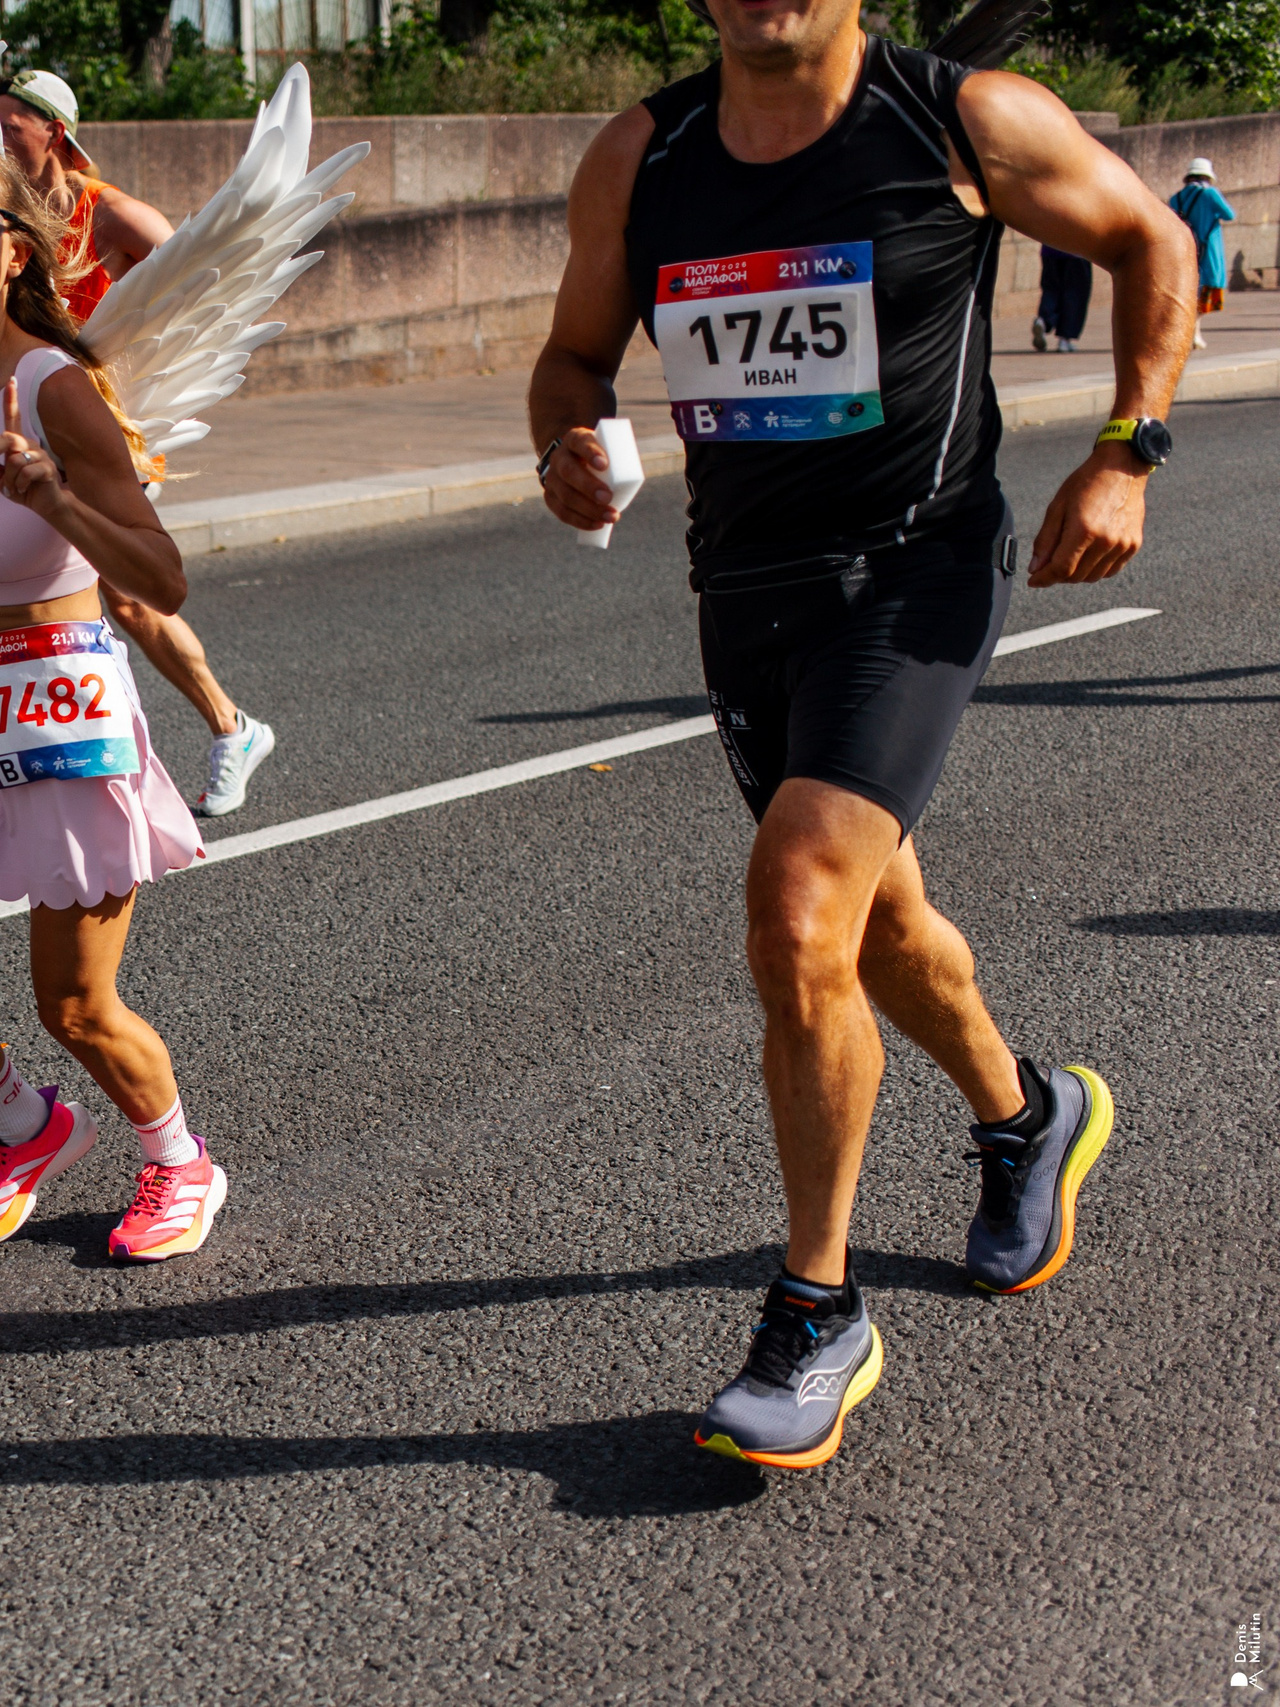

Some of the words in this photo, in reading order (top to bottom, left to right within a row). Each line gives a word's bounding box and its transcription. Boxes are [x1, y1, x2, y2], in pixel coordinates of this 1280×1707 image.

[685, 264, 720, 277] ПОЛУ
[721, 261, 747, 271] 2026
[778, 261, 808, 278] 21,1
[684, 270, 747, 288] МАРАФОН
[689, 302, 848, 365] 1745
[744, 368, 797, 386] ИВАН
[4, 633, 26, 642] 2026
[51, 631, 75, 646] 21,1
[728, 749, 752, 786] TRUST
